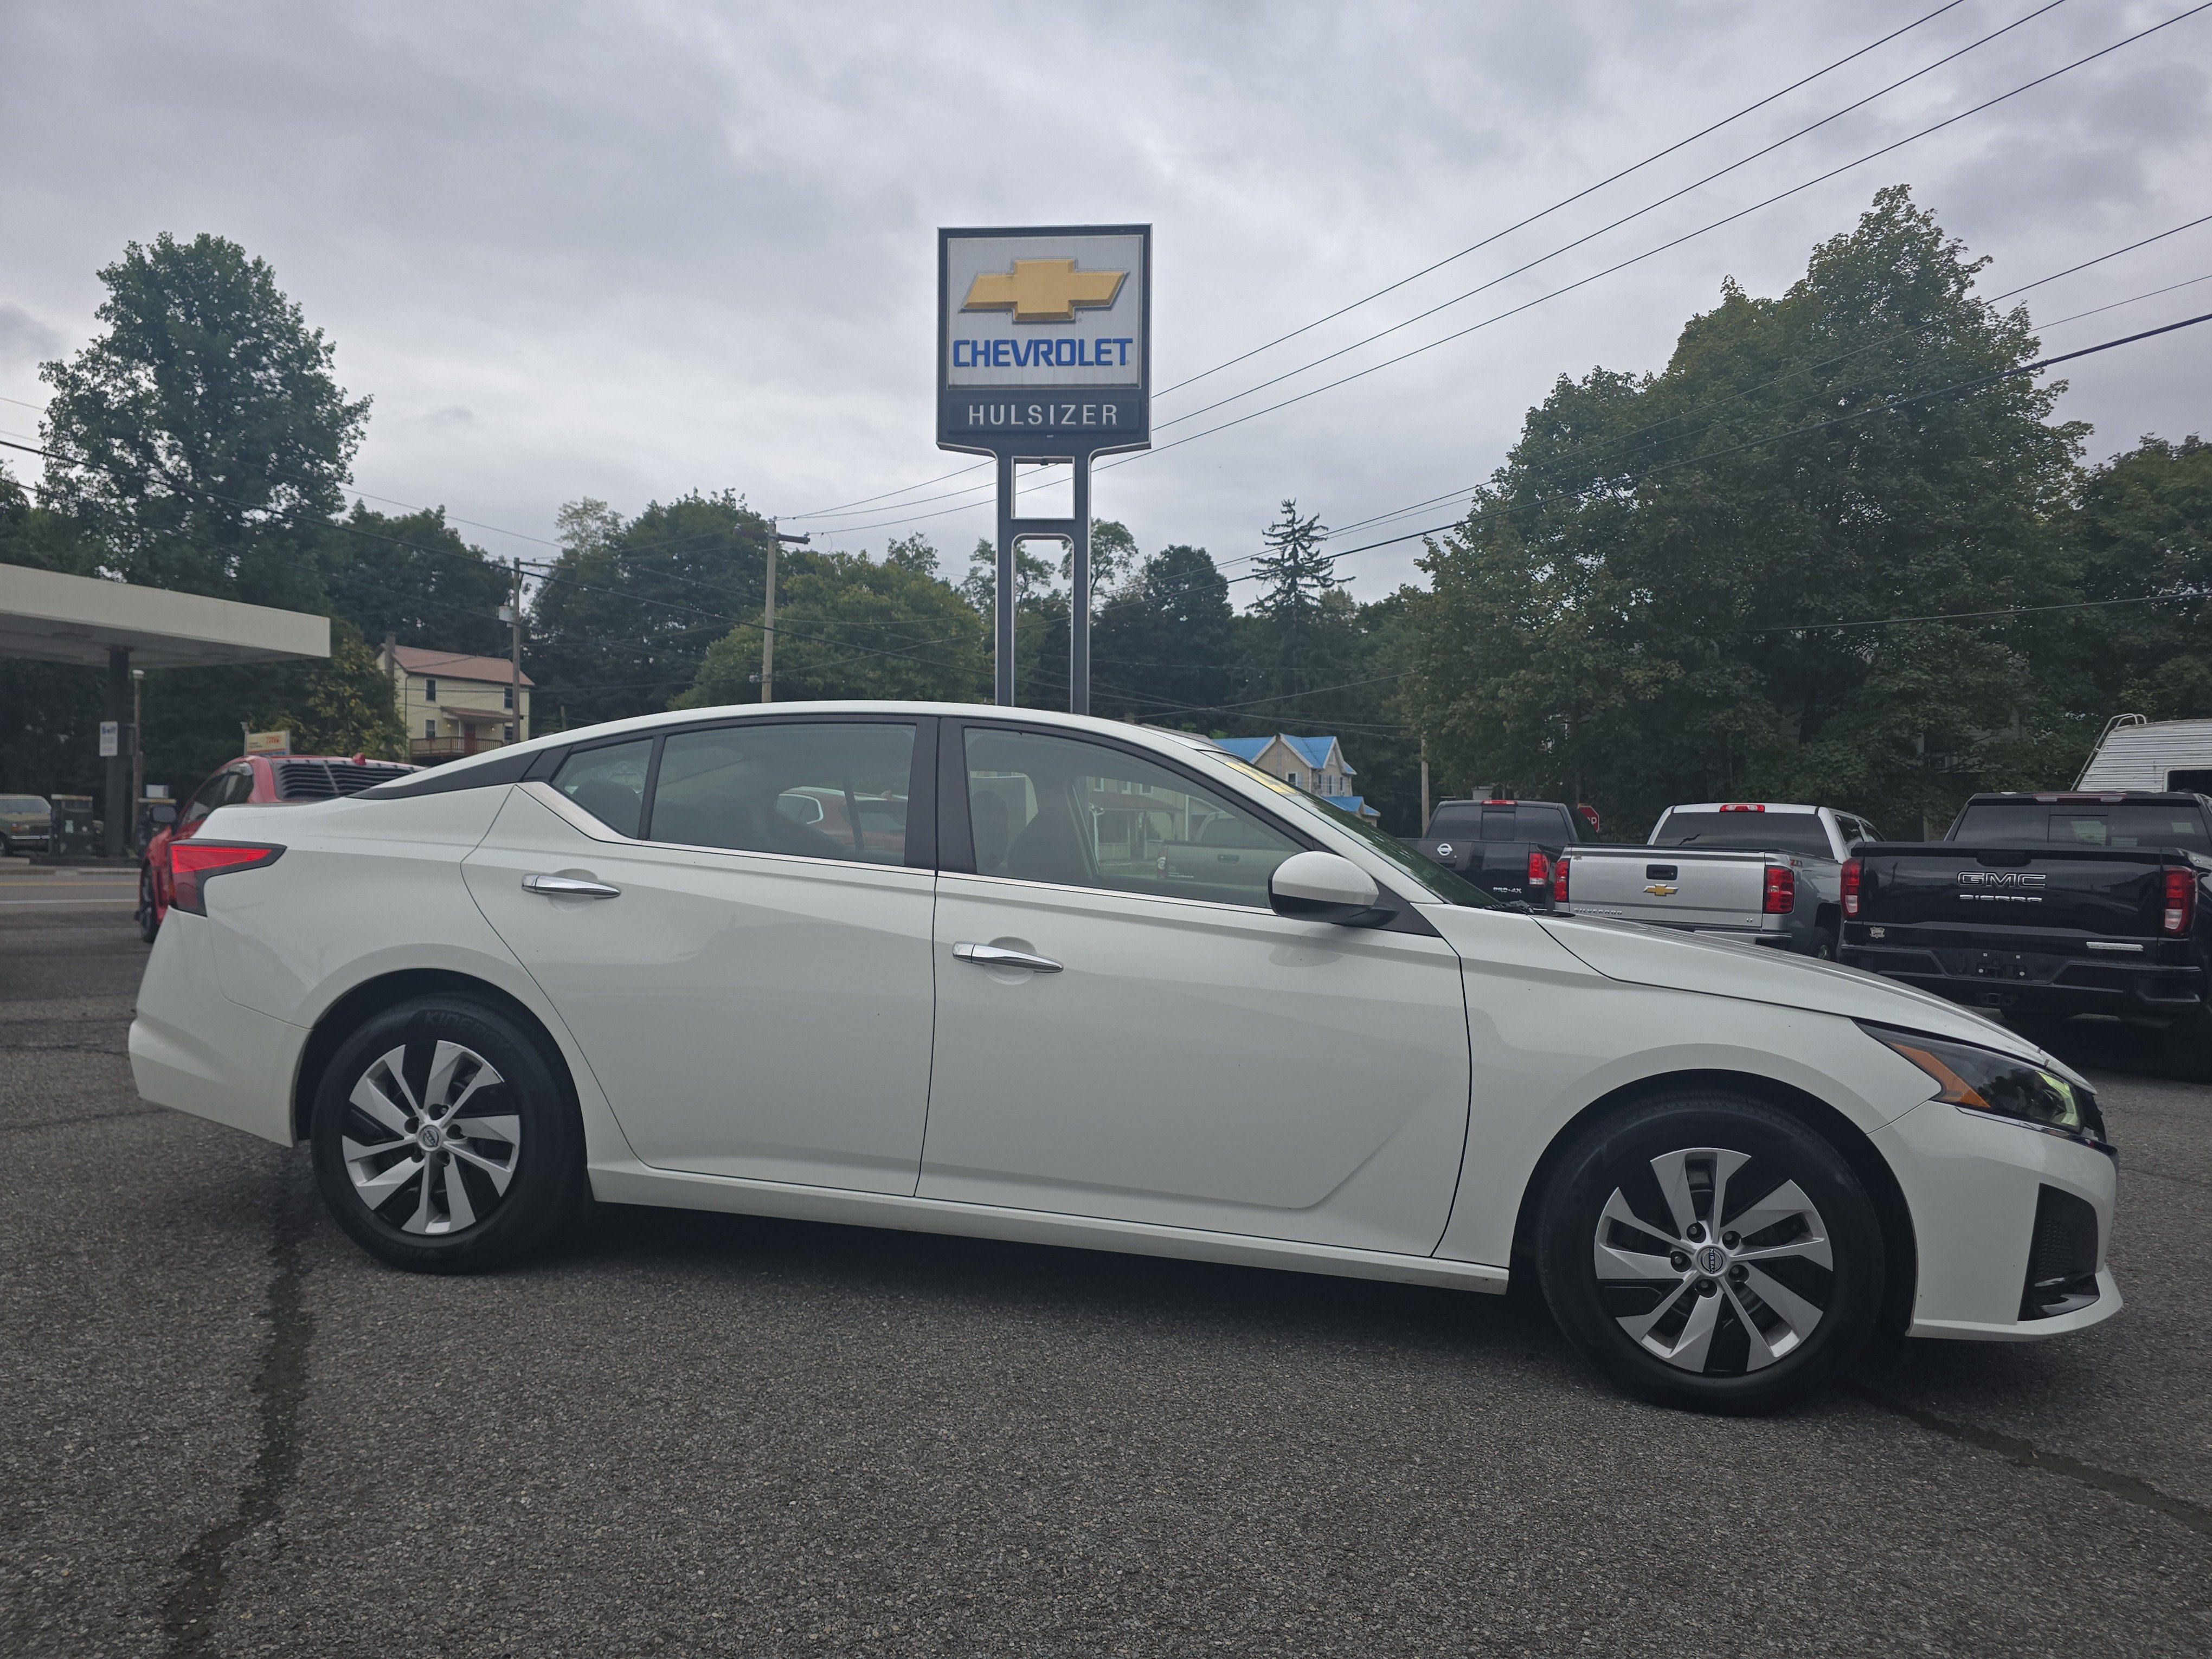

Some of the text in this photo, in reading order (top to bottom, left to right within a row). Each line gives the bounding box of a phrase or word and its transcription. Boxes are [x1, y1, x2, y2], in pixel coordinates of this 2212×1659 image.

[953, 338, 1133, 367] CHEVROLET
[968, 404, 1117, 426] HULSIZER
[1958, 871, 2047, 888] GMC
